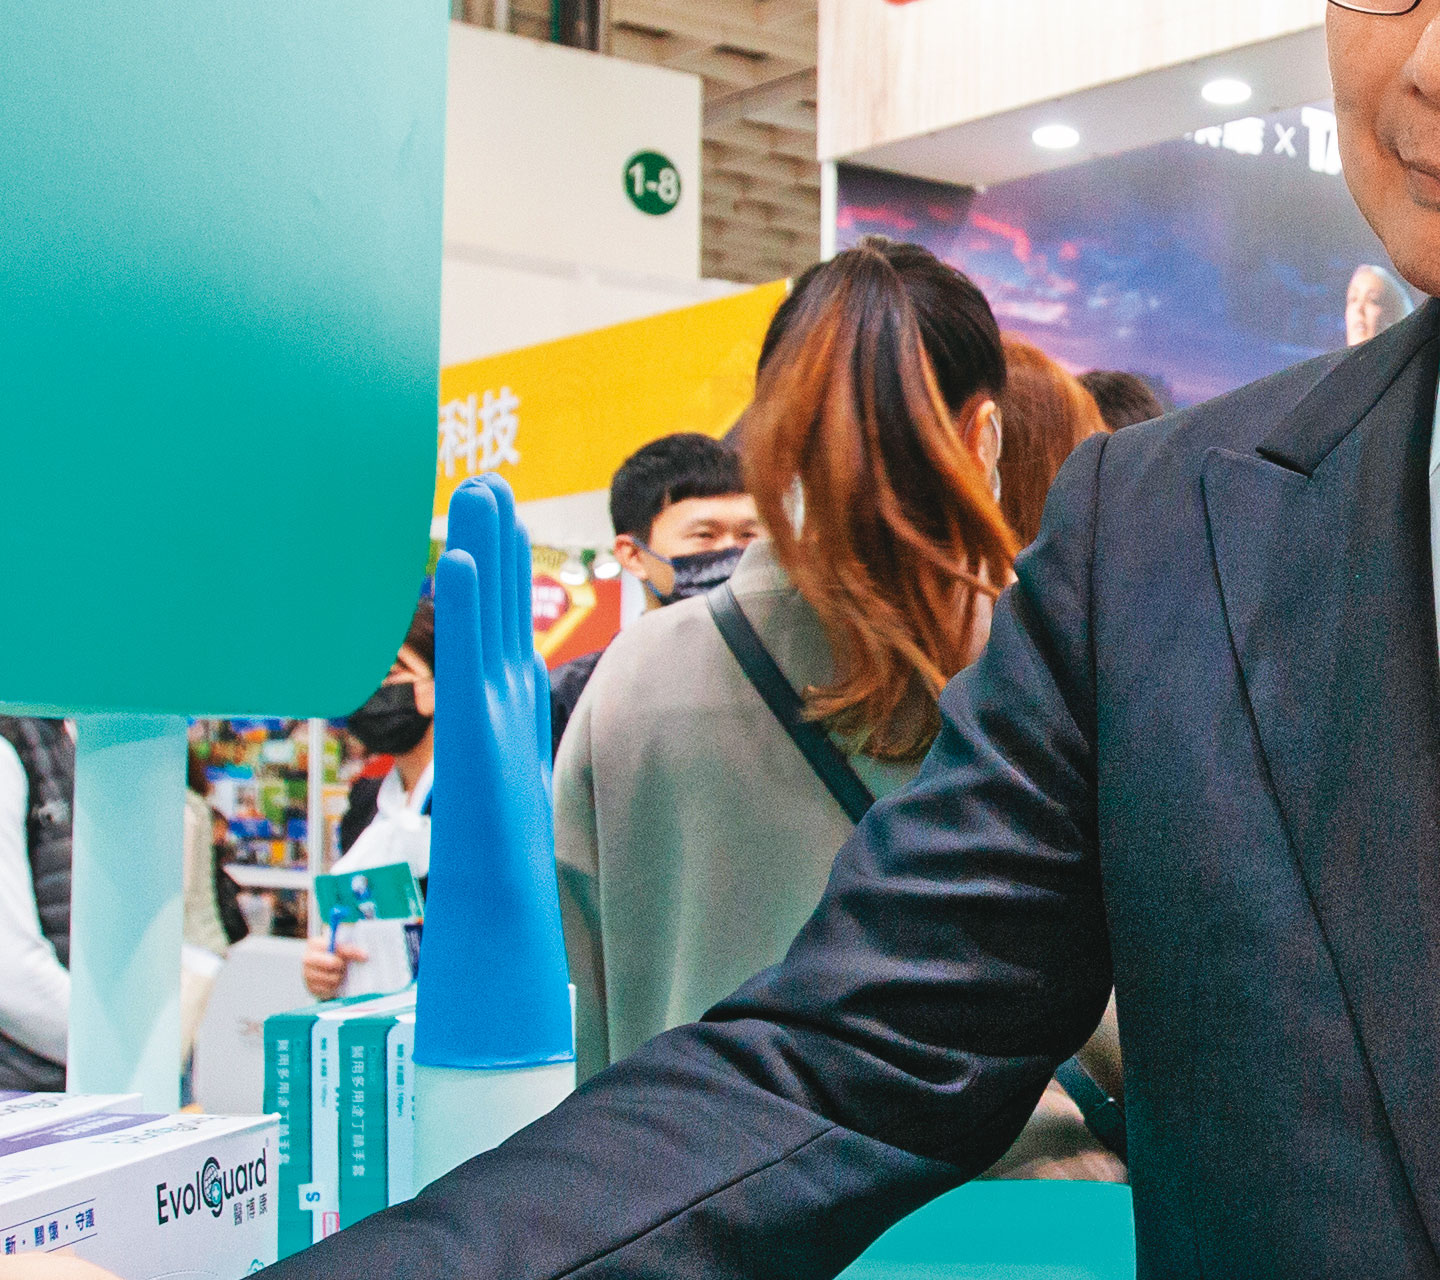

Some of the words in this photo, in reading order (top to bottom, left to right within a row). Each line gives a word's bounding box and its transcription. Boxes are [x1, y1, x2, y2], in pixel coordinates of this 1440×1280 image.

[627, 162, 679, 205] 1-8
[438, 386, 521, 478] 科技
[156, 1147, 268, 1226] EvolGuard
[305, 1191, 321, 1202] S
